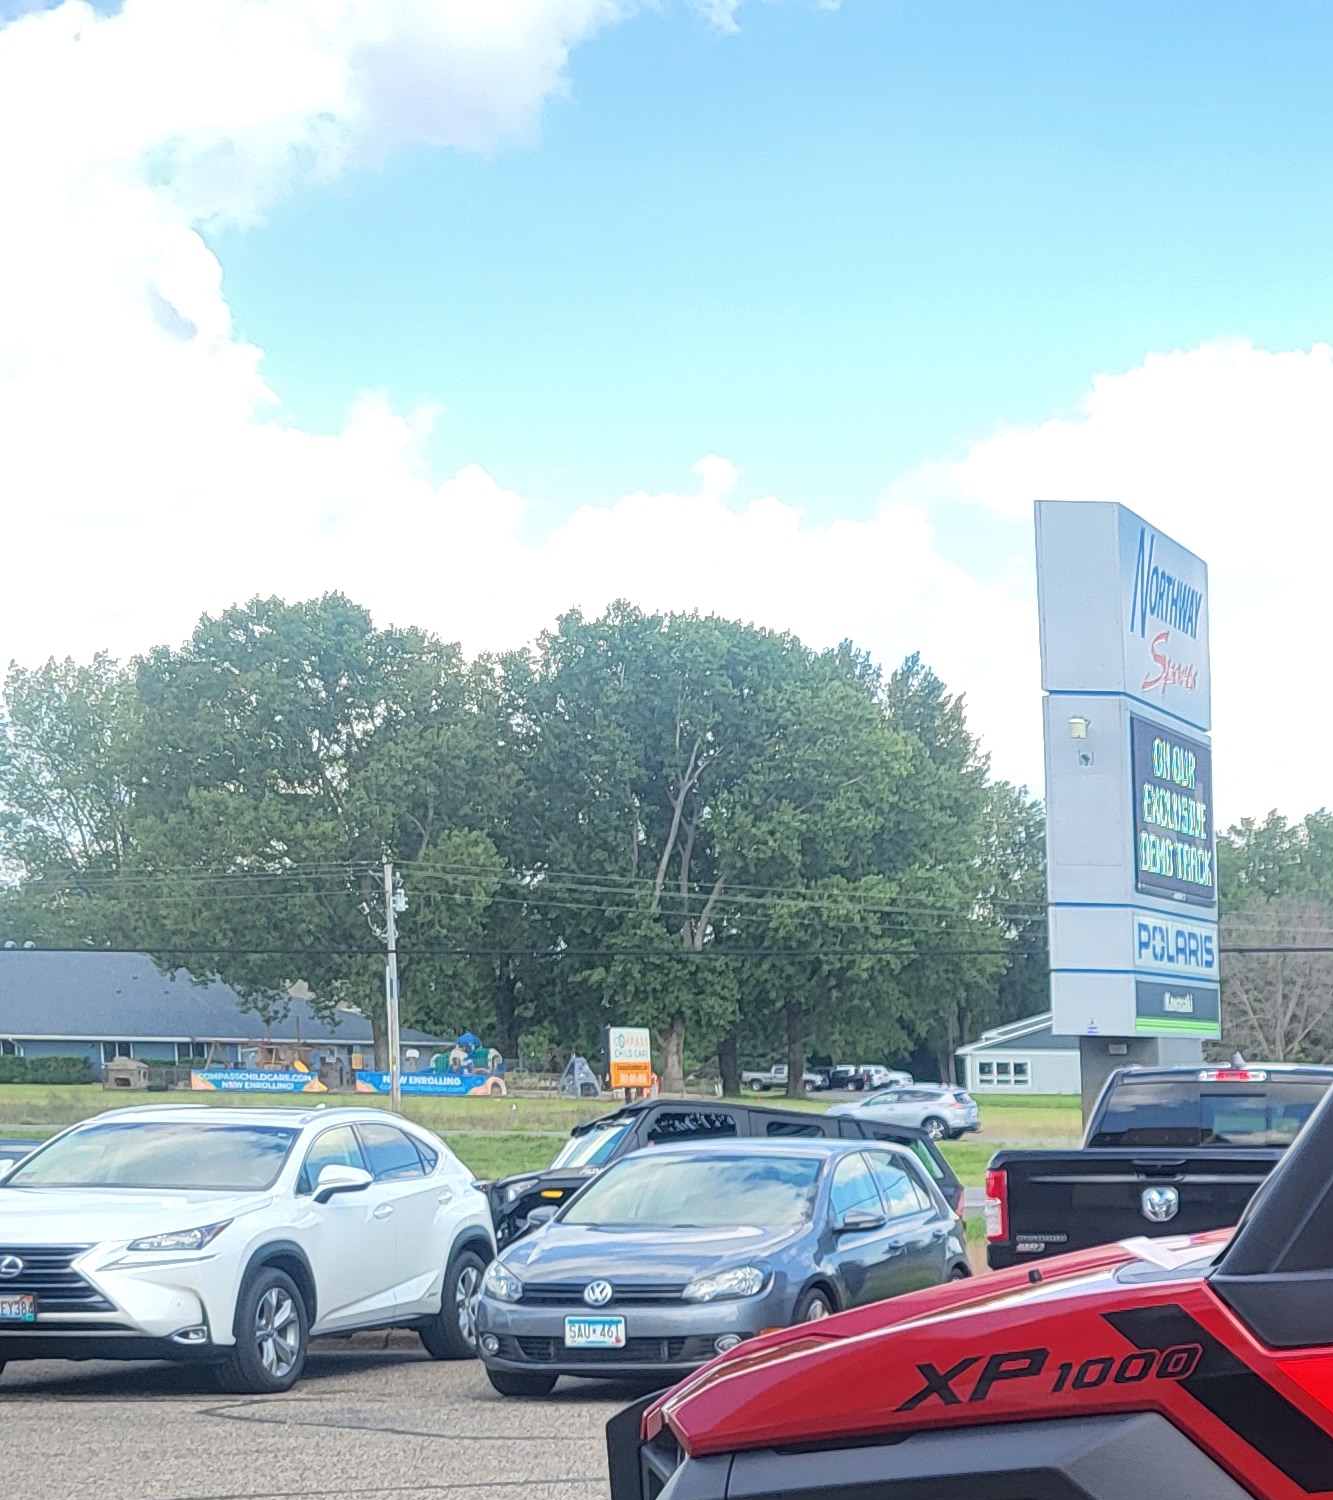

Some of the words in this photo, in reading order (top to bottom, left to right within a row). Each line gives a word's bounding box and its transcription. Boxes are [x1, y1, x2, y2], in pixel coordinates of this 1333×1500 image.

[1130, 526, 1202, 640] NORTHWAY
[1172, 745, 1196, 789] OUR
[1139, 830, 1174, 877] DEMO
[1175, 840, 1213, 886] TRACK
[1137, 922, 1215, 969] POLARIS
[382, 1075, 407, 1085] NW
[892, 1347, 1050, 1412] XP
[1050, 1343, 1203, 1393] 1000
